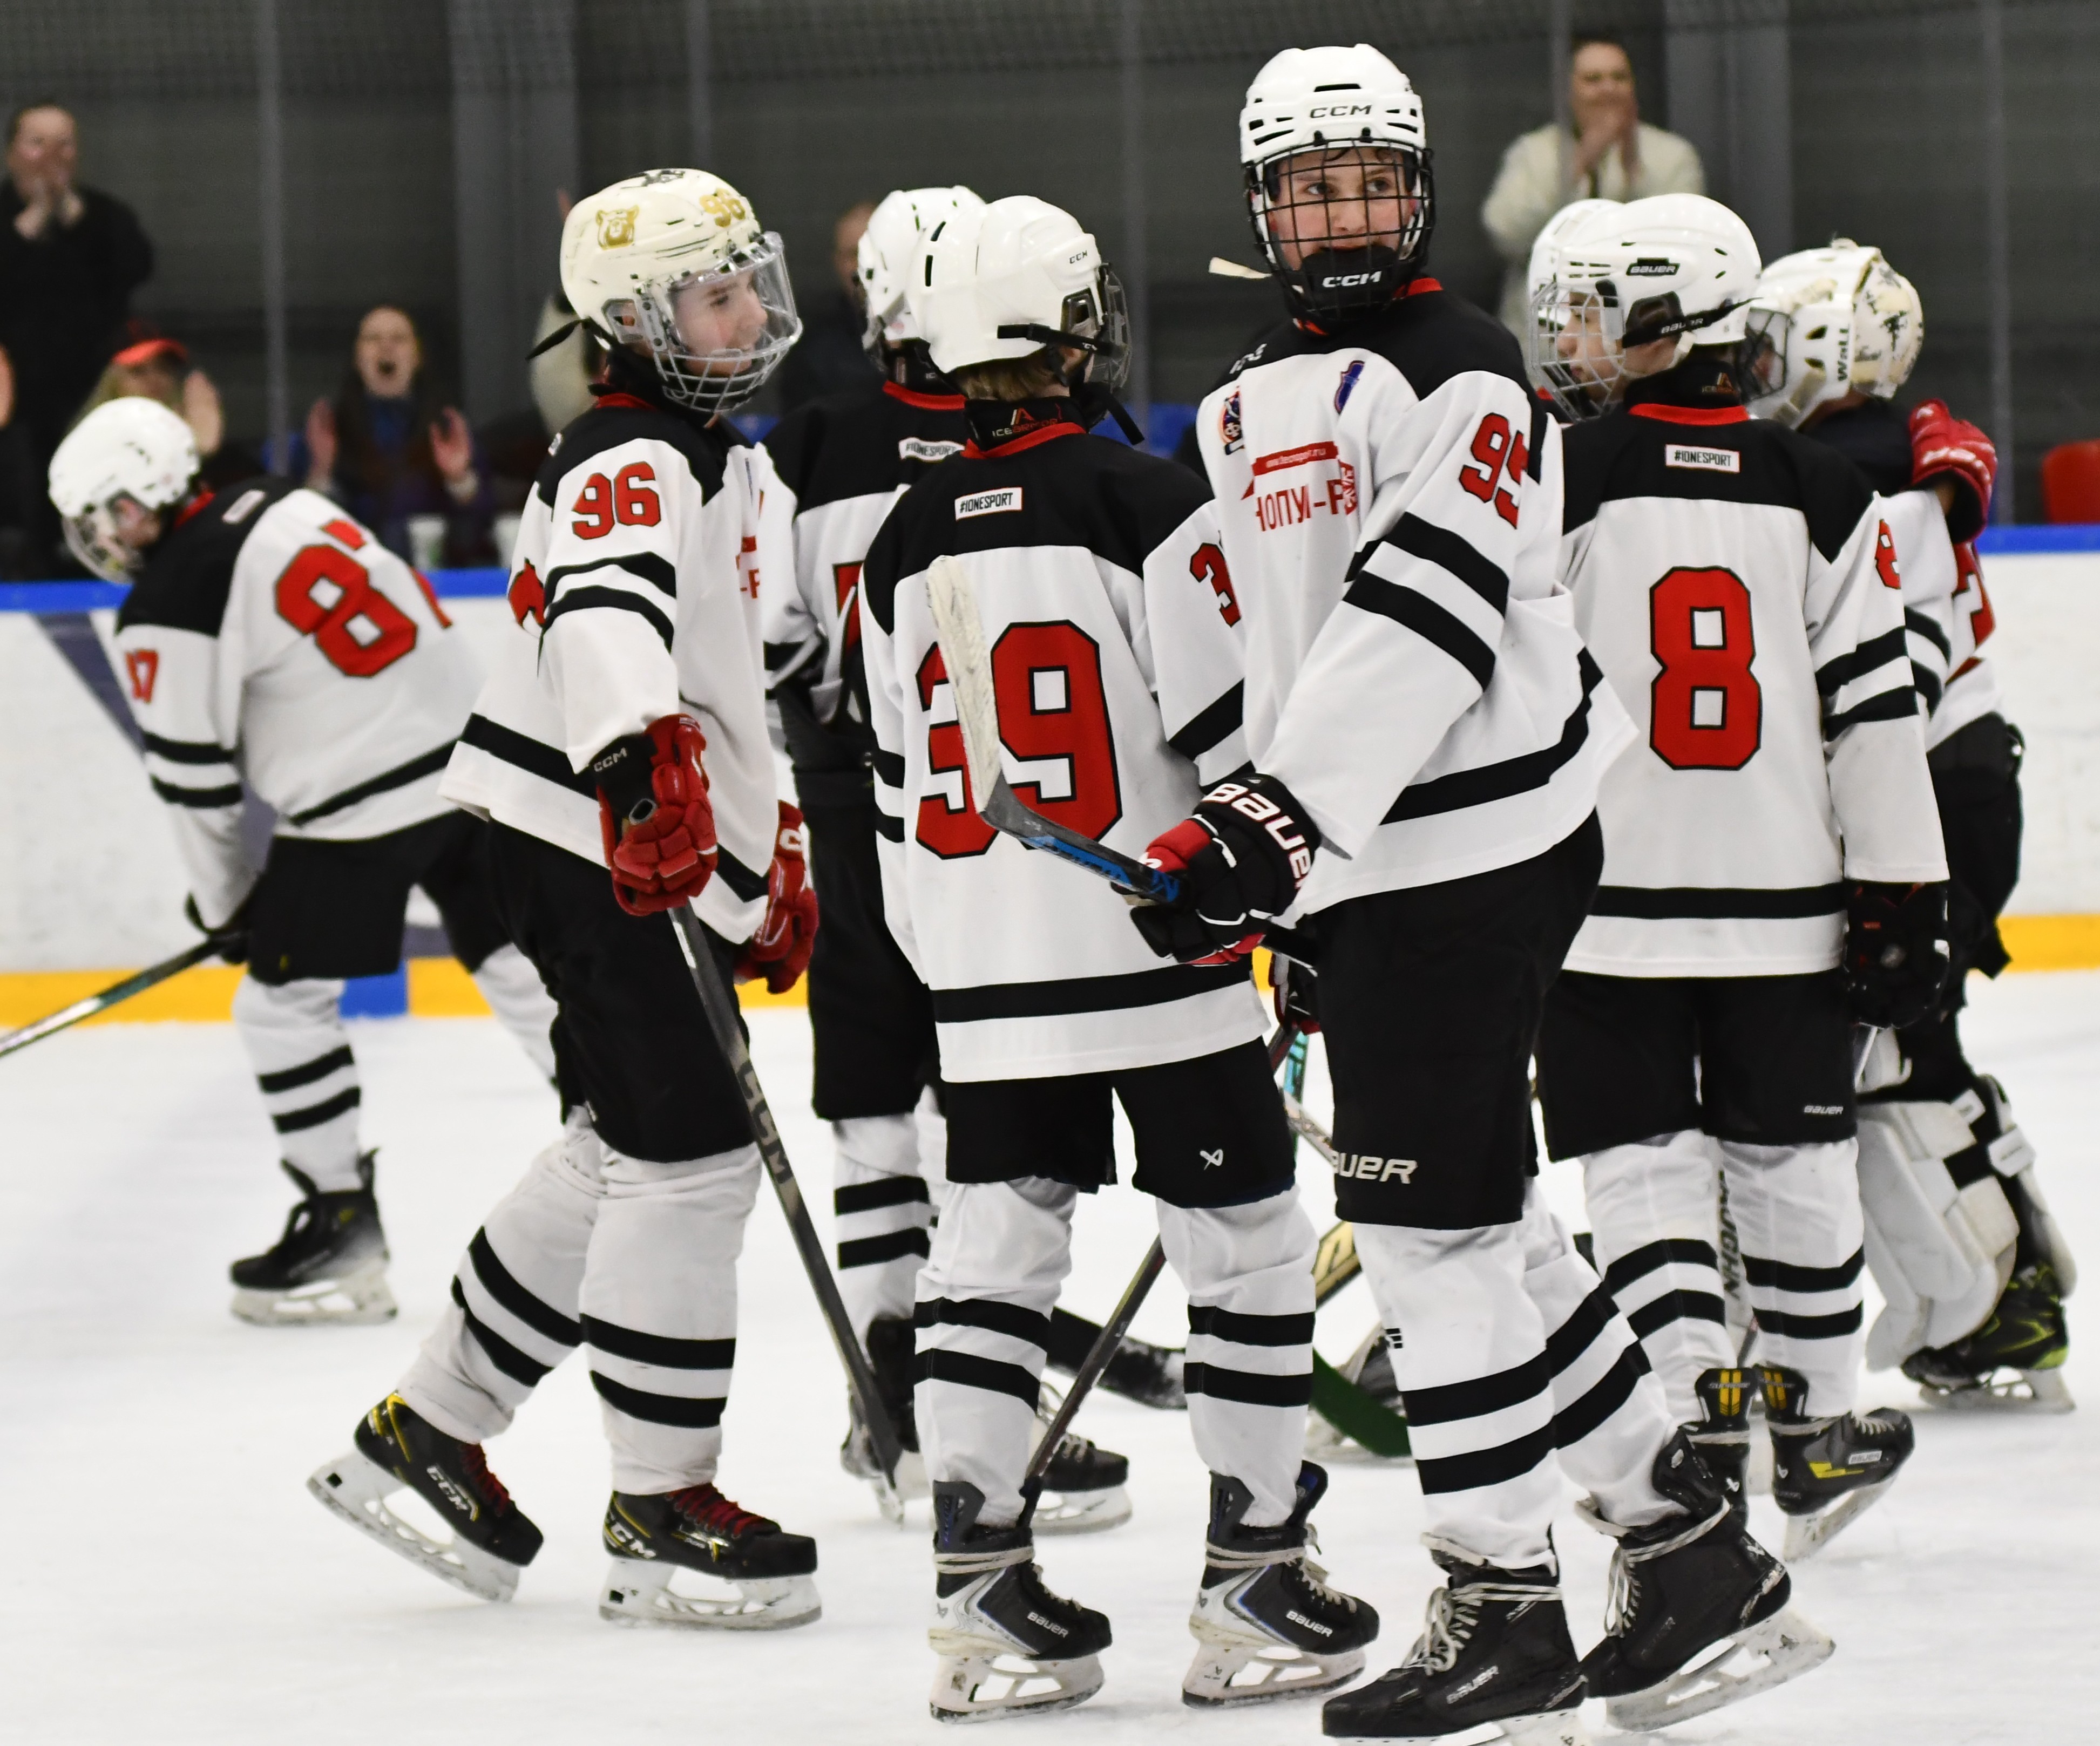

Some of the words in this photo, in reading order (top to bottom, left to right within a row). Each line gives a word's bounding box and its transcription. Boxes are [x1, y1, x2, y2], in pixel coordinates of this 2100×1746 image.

[1310, 105, 1372, 118] CCM
[699, 188, 746, 228] 96
[1069, 250, 1087, 264] CCM
[1322, 270, 1381, 288] CCM
[571, 461, 661, 540] 96
[1189, 542, 1242, 628] 3
[1650, 566, 1761, 771] 8
[594, 747, 627, 772] CCM
[915, 619, 1123, 860] 39
[1201, 783, 1311, 889] BAUE
[737, 1059, 794, 1184] CCM
[1333, 1151, 1418, 1184] UER
[426, 1466, 468, 1510] CCM
[609, 1512, 656, 1559] CM
[1027, 1611, 1069, 1639] BAUER
[1286, 1611, 1333, 1638] BAUER
